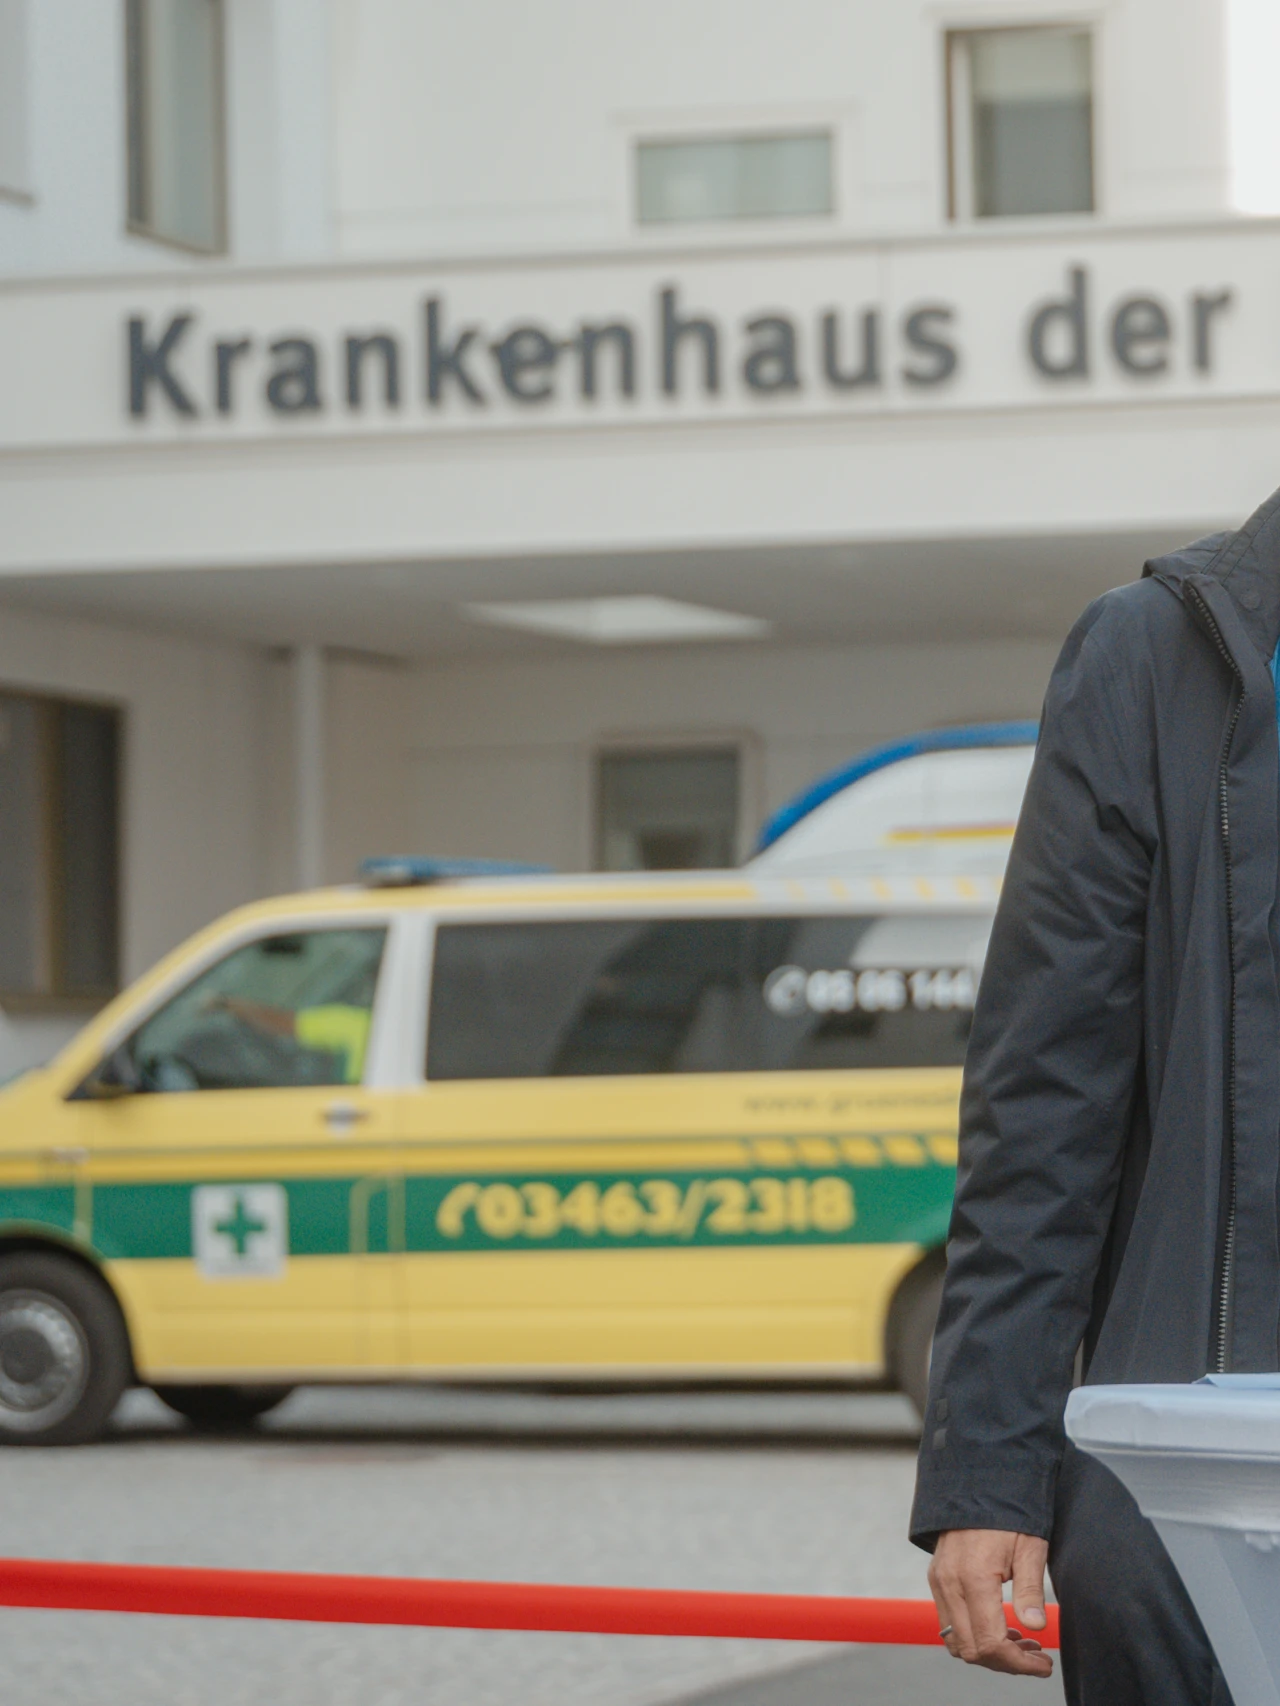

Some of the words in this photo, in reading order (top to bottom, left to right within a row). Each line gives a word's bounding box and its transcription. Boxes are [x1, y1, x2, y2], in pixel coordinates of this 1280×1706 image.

[124, 284, 958, 421] Krankenhaus
[1026, 265, 1232, 384] der
[474, 1176, 857, 1241] 03463/2318
